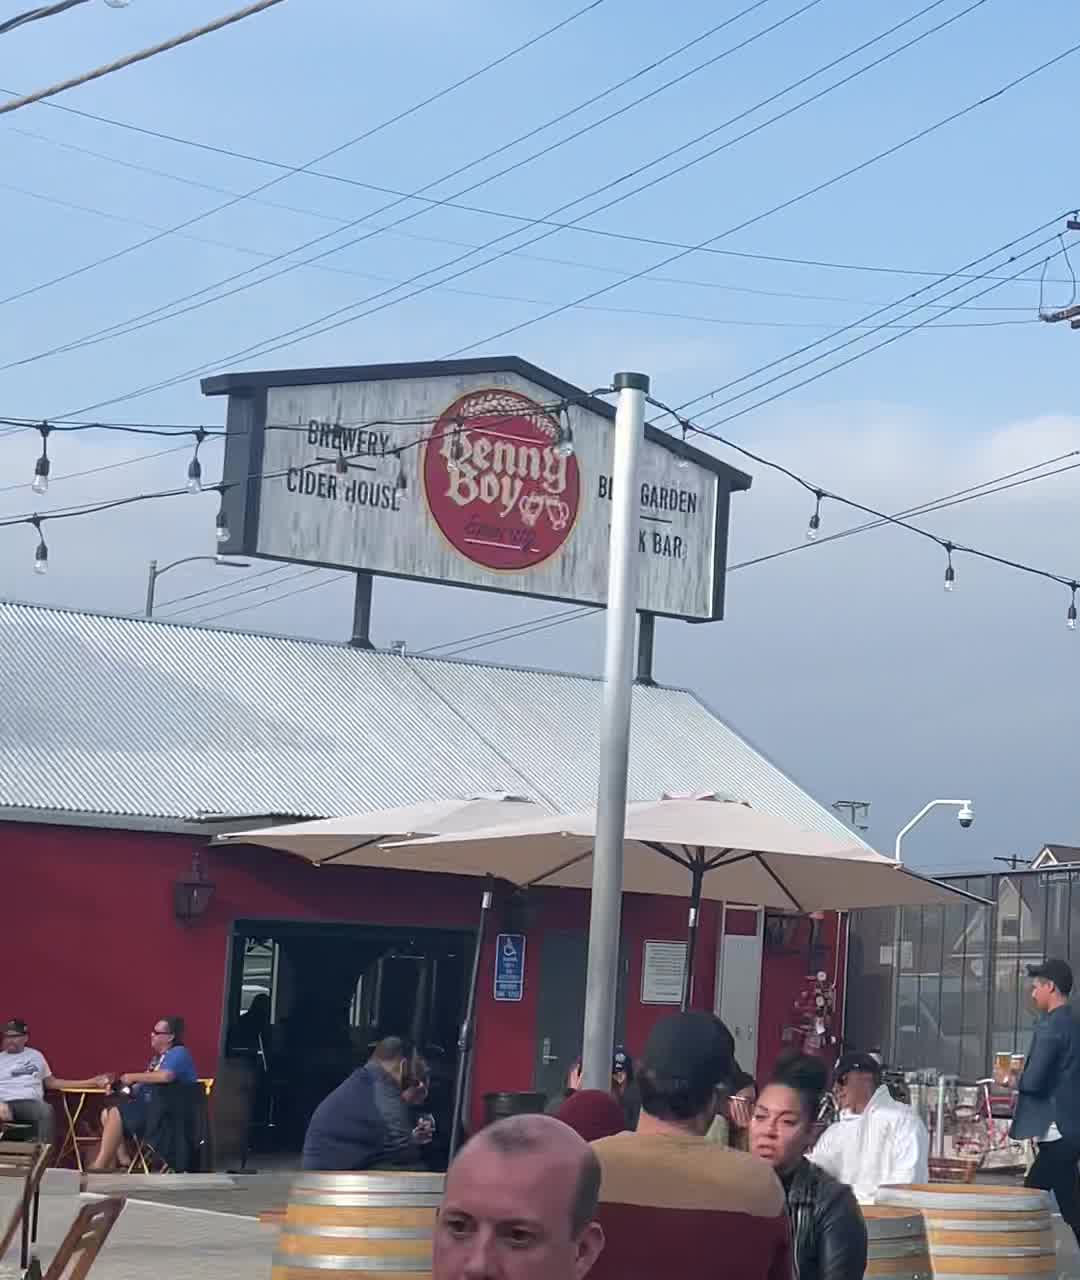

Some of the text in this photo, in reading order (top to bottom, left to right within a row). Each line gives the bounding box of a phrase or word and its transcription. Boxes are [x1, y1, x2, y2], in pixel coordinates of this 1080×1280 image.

[308, 419, 389, 458] BREWERY
[287, 467, 337, 501] CIDER
[444, 462, 524, 518] Boy
[640, 483, 697, 514] GARDEN
[652, 532, 683, 559] BAR
